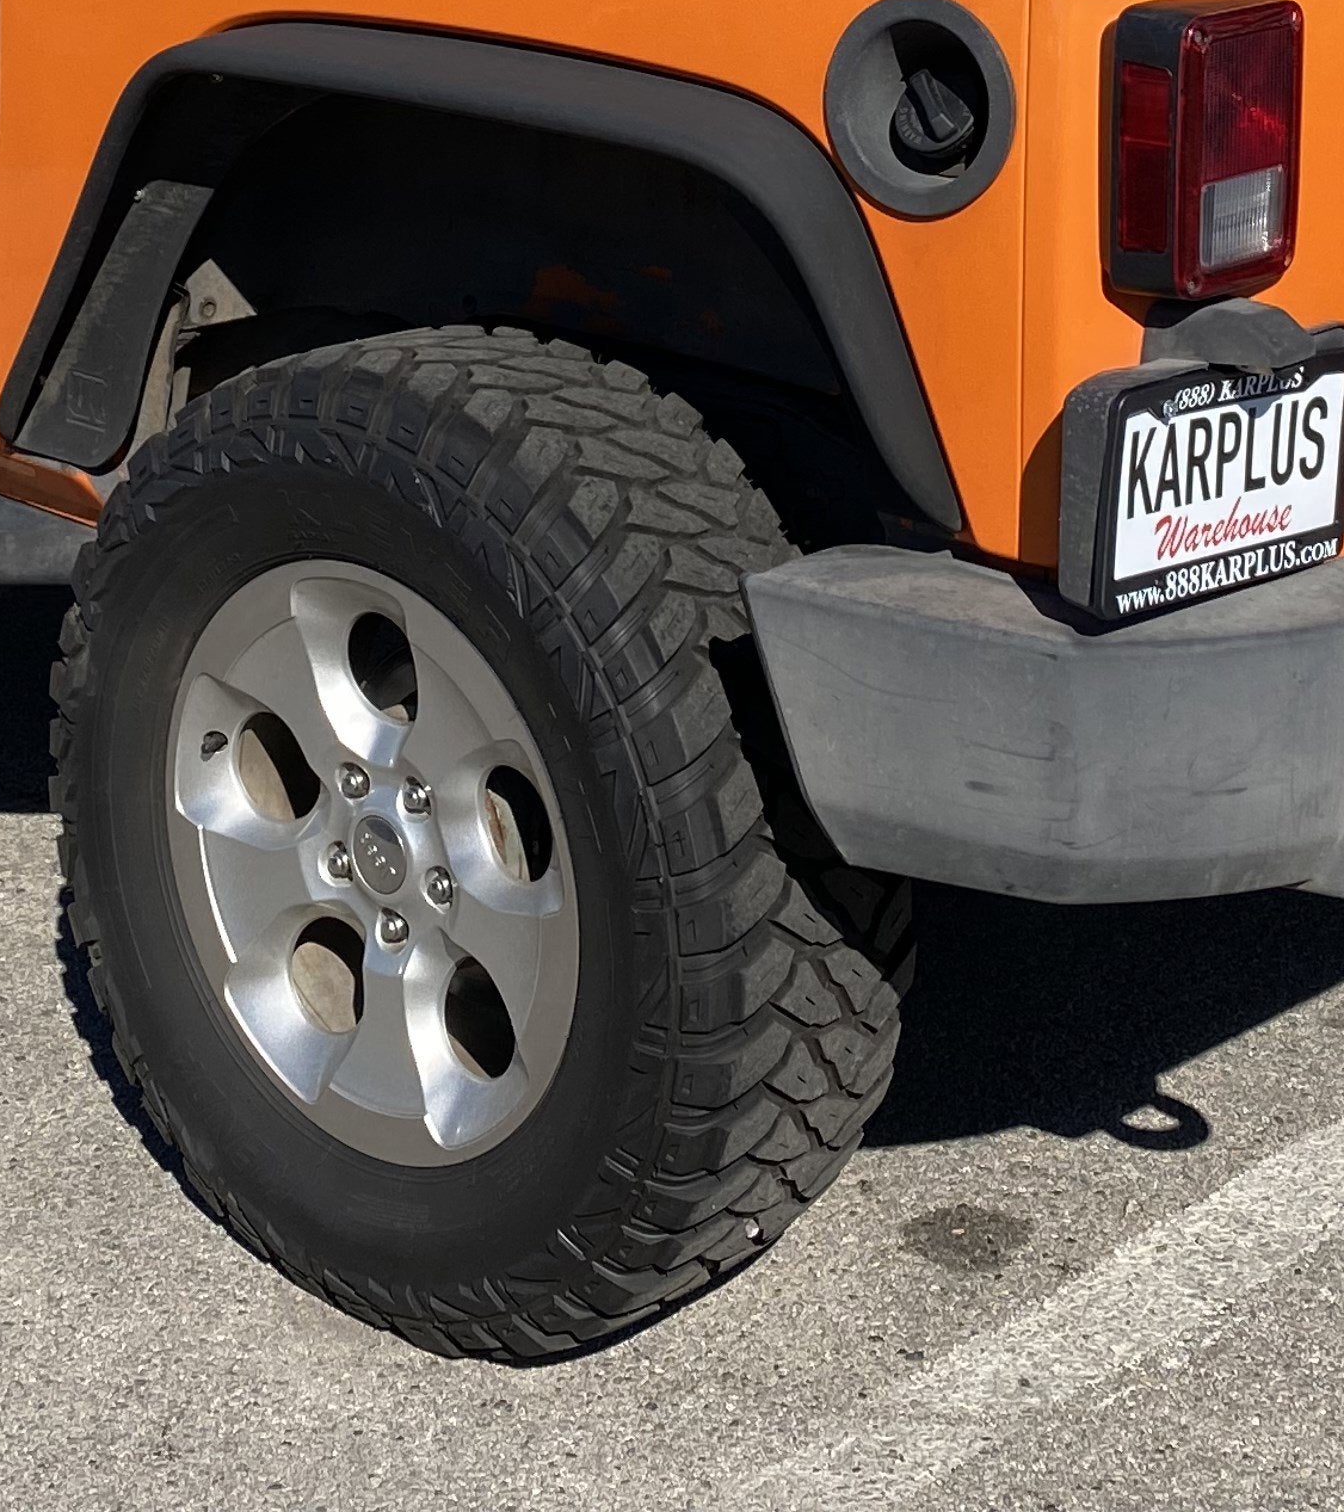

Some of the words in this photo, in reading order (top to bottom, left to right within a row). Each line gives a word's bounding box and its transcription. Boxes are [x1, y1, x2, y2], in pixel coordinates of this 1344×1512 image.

[1174, 380, 1216, 411] (888)
[1126, 395, 1329, 520] KARPLUS
[1153, 496, 1293, 561] Warehouse
